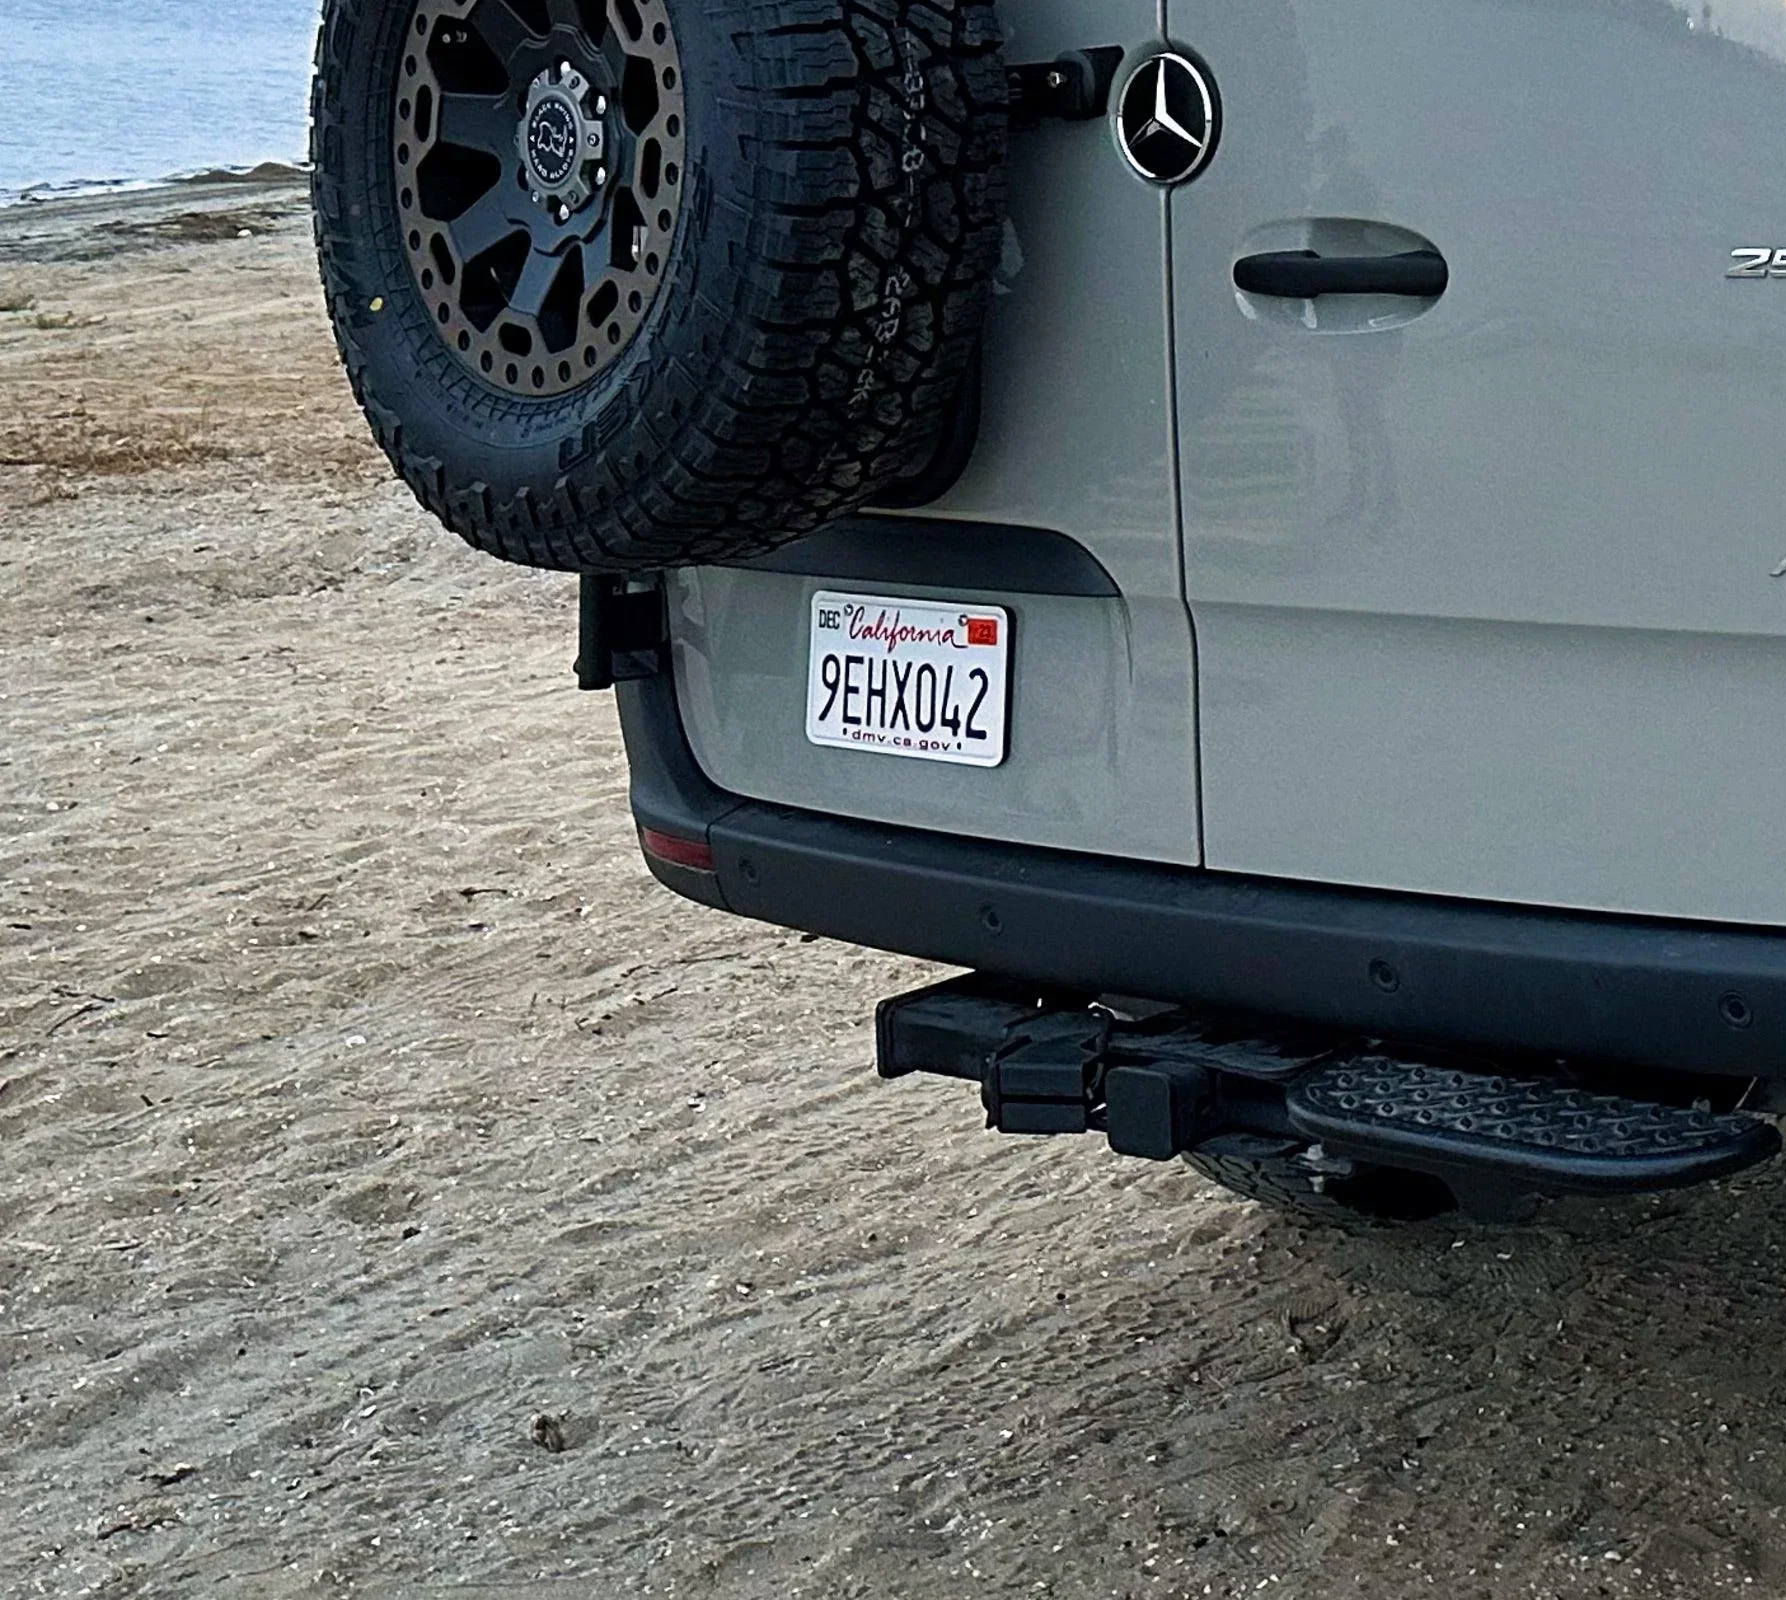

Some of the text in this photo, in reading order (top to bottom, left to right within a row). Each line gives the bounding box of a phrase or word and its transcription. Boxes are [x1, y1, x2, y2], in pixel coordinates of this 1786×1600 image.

[818, 609, 841, 630] DEC
[849, 606, 968, 653] California
[818, 654, 989, 740] 9EHX042
[852, 729, 951, 751] dmv.ca.gov
